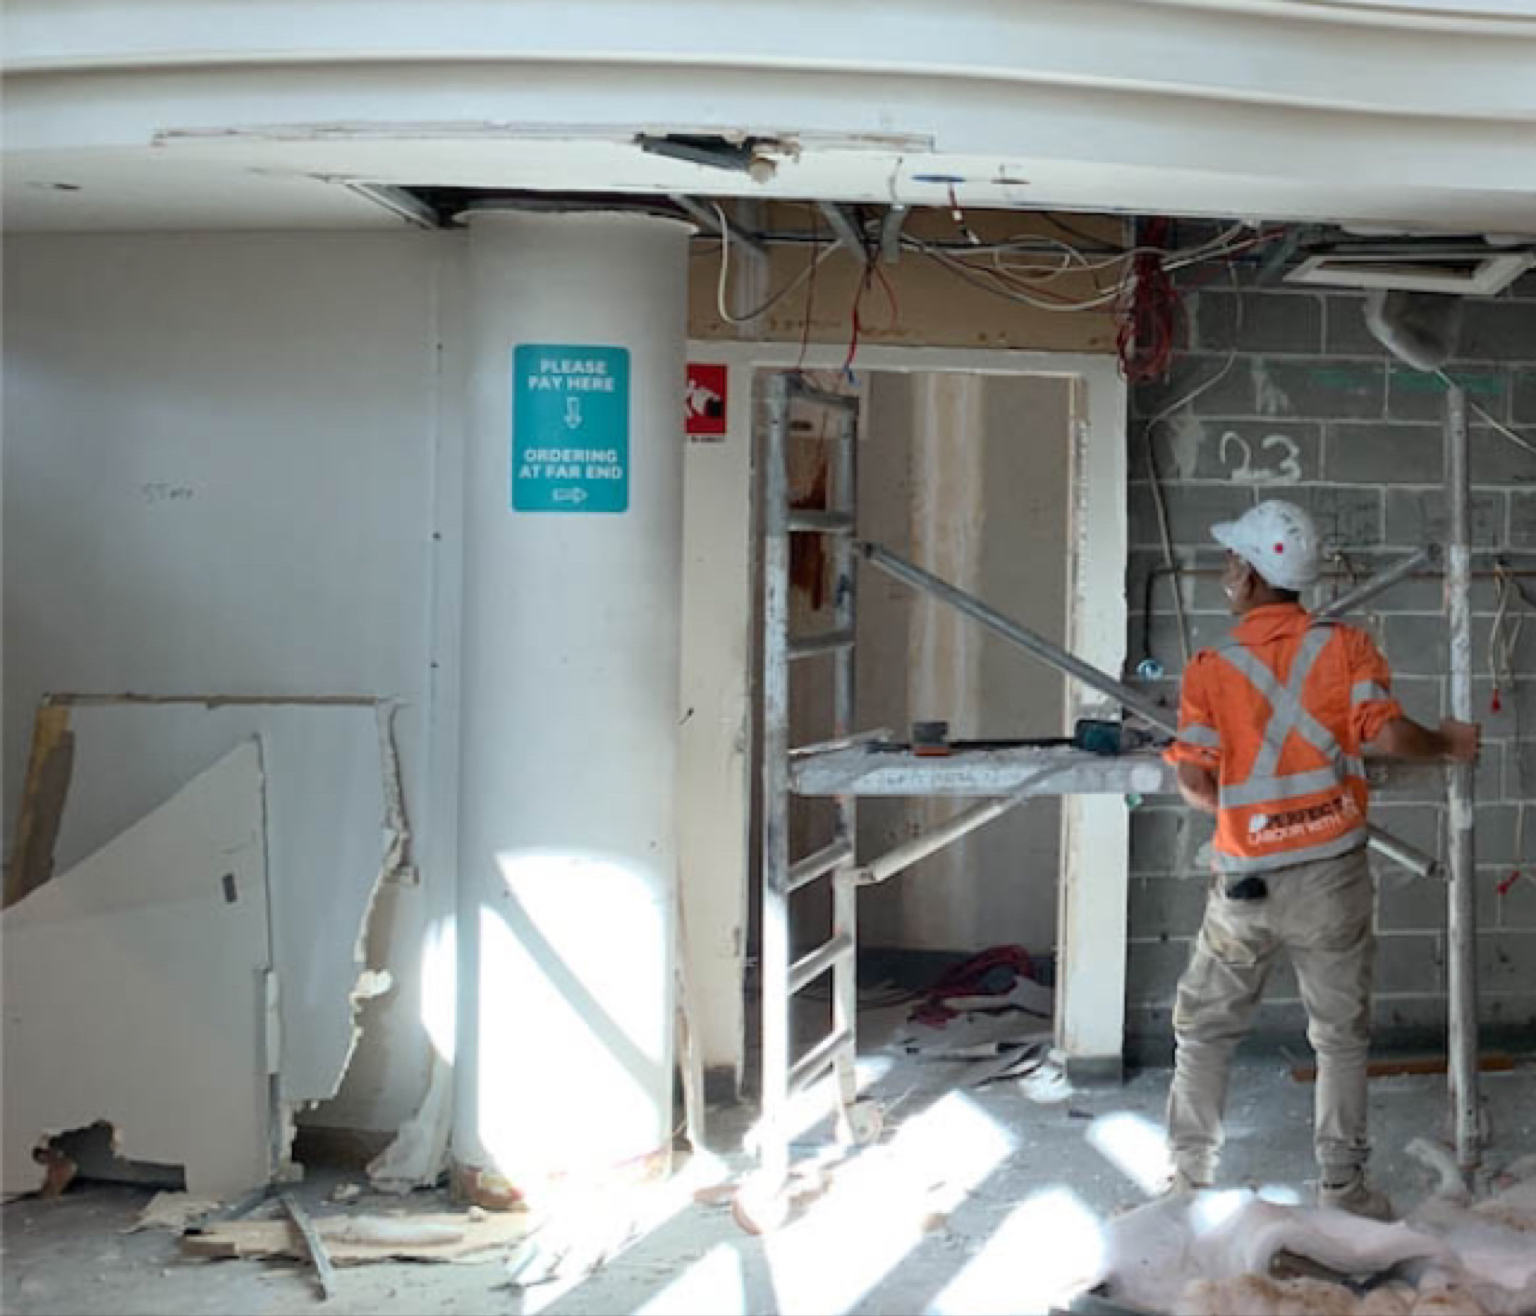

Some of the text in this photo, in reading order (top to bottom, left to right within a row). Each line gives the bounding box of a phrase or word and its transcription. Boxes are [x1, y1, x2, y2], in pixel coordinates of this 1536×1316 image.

[540, 359, 607, 374] PLEASE
[527, 375, 614, 391] PAY HERE
[525, 448, 618, 463] ORDERING
[1219, 431, 1301, 481] 23
[519, 463, 623, 479] AT FAR END
